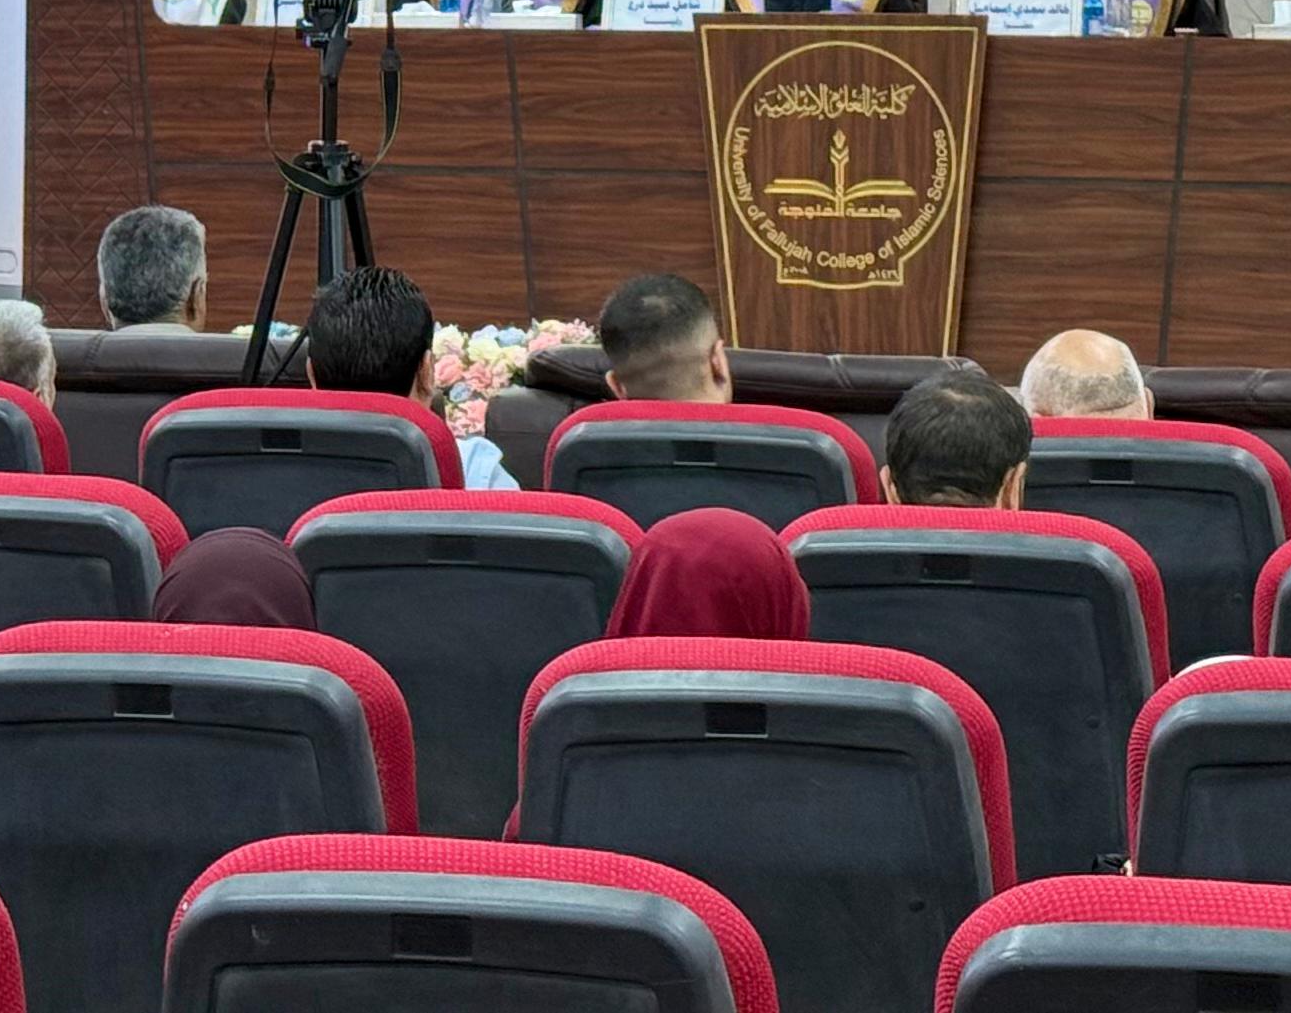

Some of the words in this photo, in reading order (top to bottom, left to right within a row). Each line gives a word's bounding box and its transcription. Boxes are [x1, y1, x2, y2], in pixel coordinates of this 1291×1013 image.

[732, 127, 754, 205] University
[748, 203, 766, 222] of
[759, 217, 813, 265] Fallujah
[817, 250, 876, 270] College
[878, 239, 895, 260] of
[892, 202, 936, 249] Islamic
[927, 128, 949, 201] Sciences
[846, 203, 902, 221] جامعة
